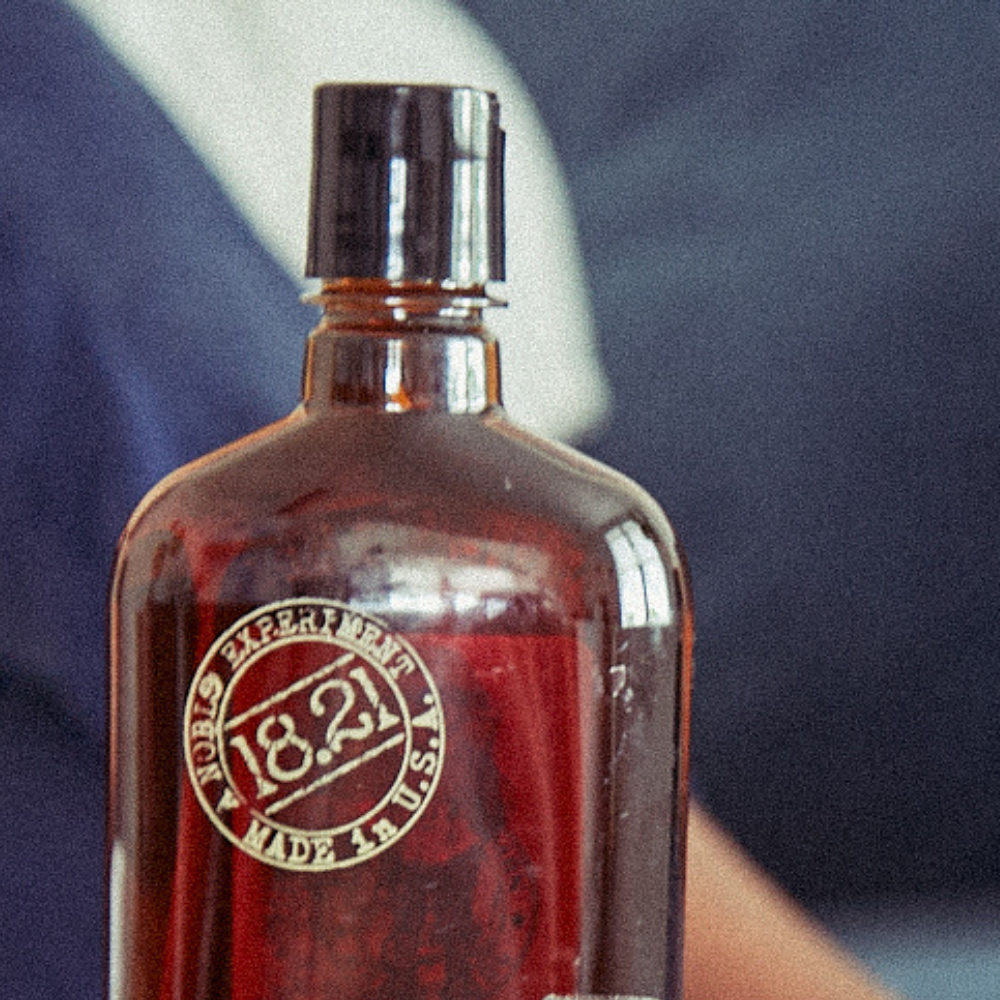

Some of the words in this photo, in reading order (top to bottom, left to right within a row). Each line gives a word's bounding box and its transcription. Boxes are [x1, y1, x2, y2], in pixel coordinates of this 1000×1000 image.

[221, 607, 416, 680] EXPERIMENT
[230, 667, 400, 799] 18.21
[242, 819, 336, 864] MADE
